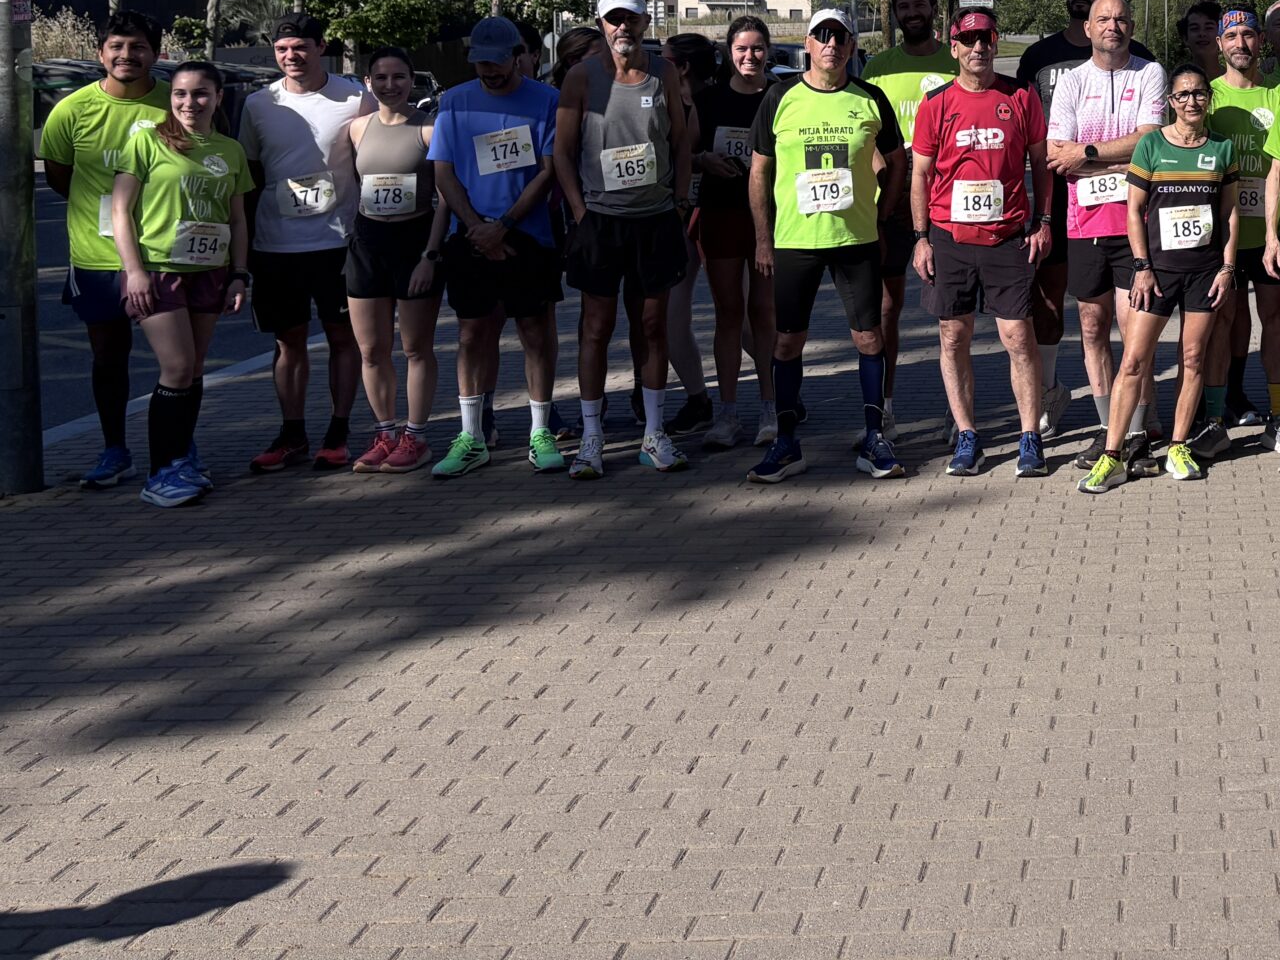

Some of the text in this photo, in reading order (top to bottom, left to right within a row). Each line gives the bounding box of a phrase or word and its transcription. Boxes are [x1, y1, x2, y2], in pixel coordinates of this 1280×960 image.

[900, 100, 921, 117] VIV
[798, 127, 821, 136] MITJA
[490, 141, 520, 162] 174
[615, 158, 647, 179] 165
[1240, 154, 1263, 172] VIDA
[810, 183, 840, 201] 179
[1089, 176, 1118, 194] 183
[1157, 185, 1218, 193] CERDANYOLA
[290, 187, 320, 208] 177
[374, 188, 403, 205] 178
[963, 195, 993, 212] 184
[1239, 190, 1259, 207] 68
[1172, 220, 1202, 238] 185
[186, 237, 218, 255] 154
